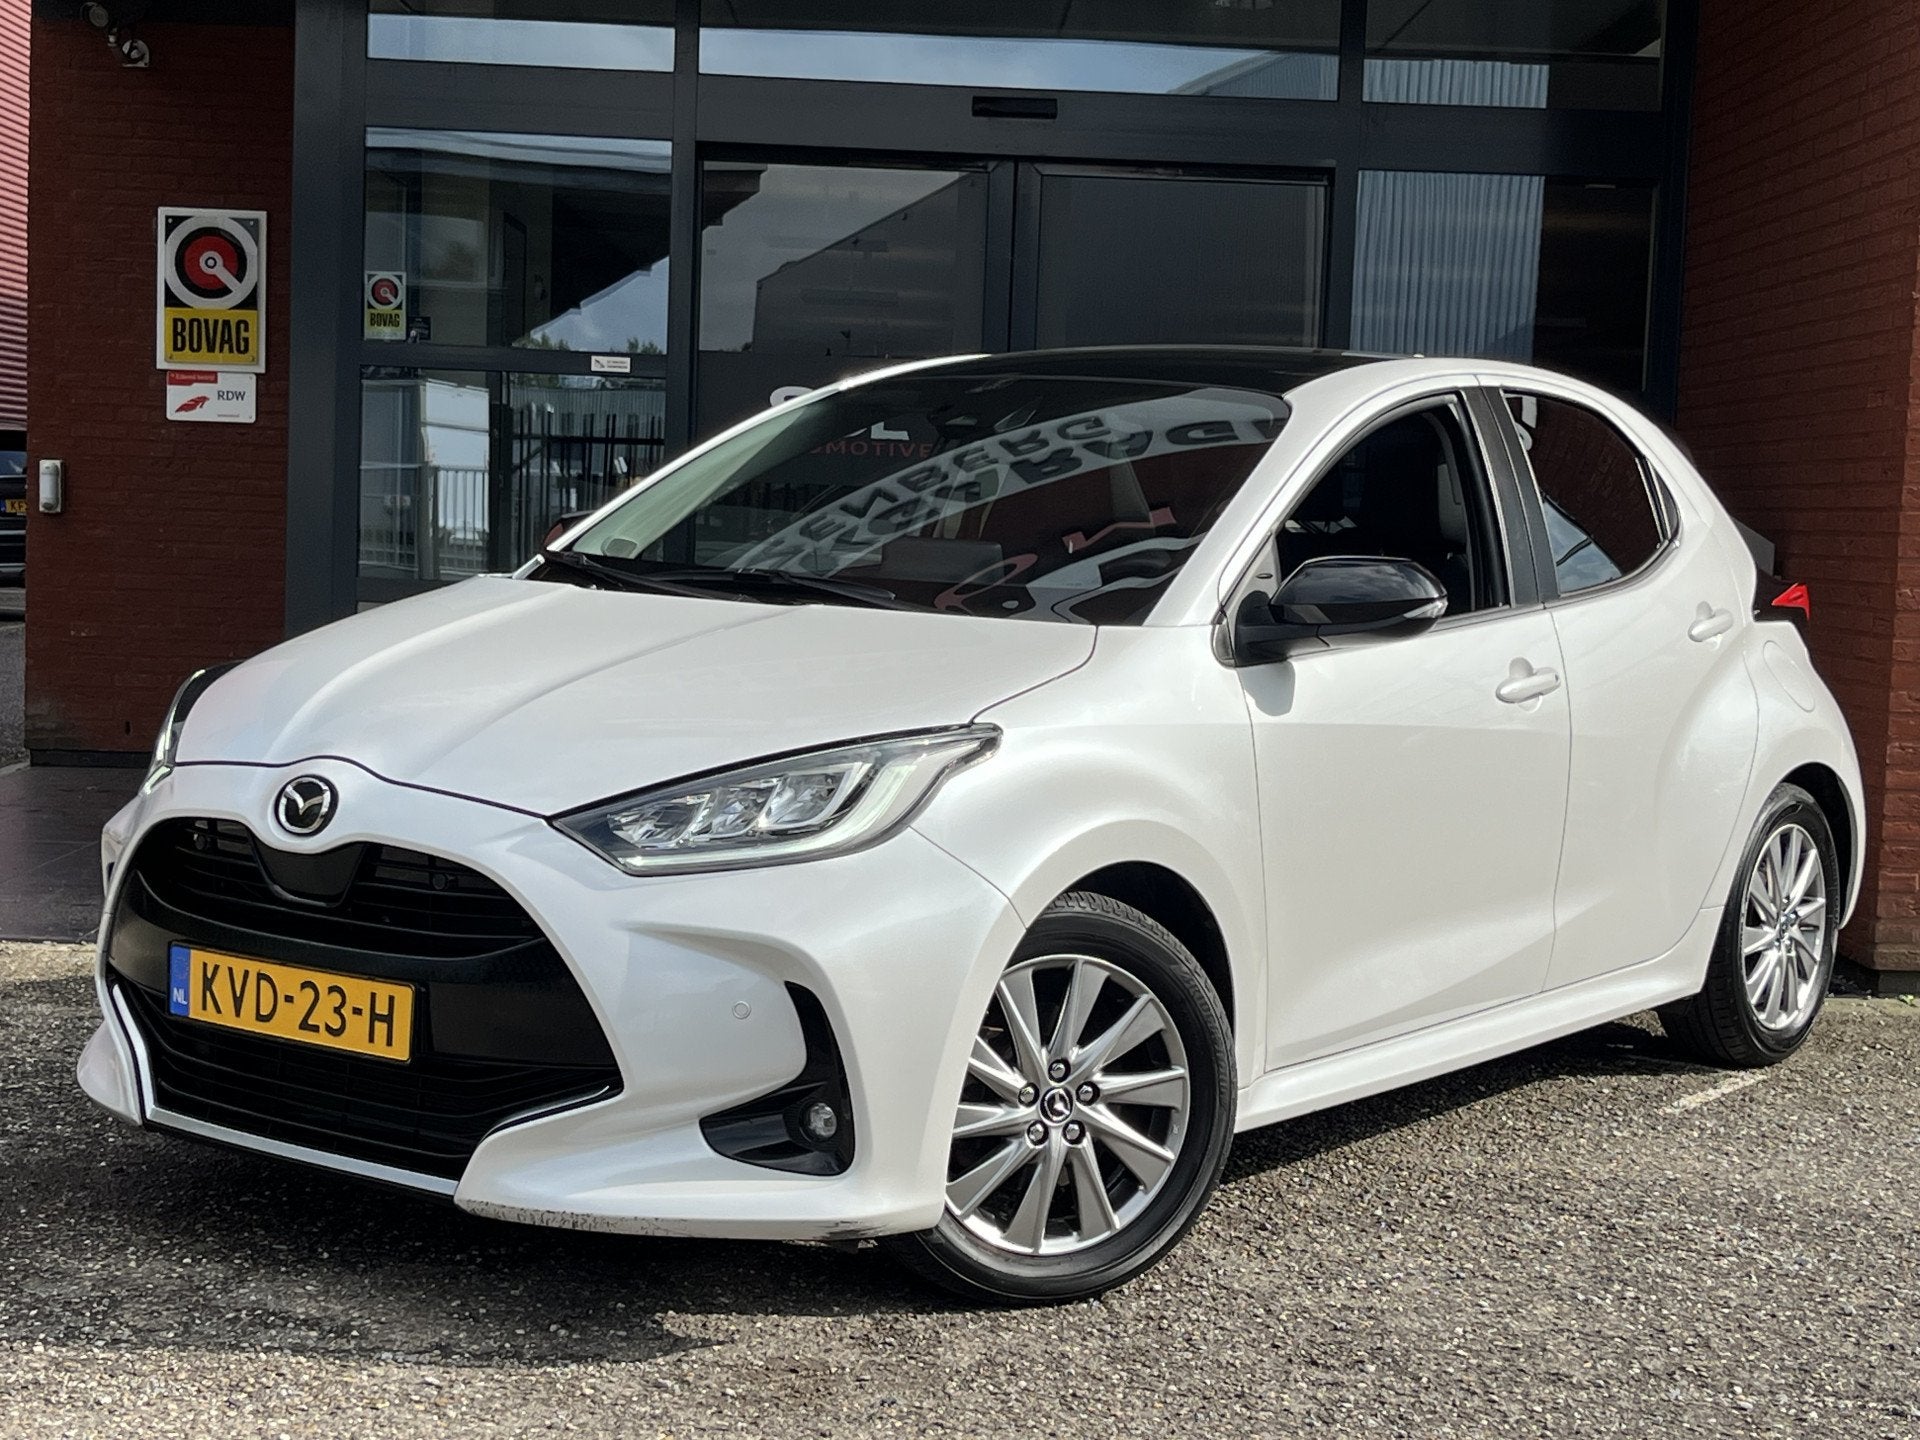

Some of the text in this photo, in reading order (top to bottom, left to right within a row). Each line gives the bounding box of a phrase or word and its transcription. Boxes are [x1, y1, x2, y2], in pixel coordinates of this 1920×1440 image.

[370, 312, 400, 327] BOVAG
[172, 317, 250, 355] BOVAG
[217, 390, 246, 401] RDW
[809, 440, 934, 458] MOTIVE
[173, 987, 188, 1005] NL
[202, 962, 396, 1047] KVD-23-H
